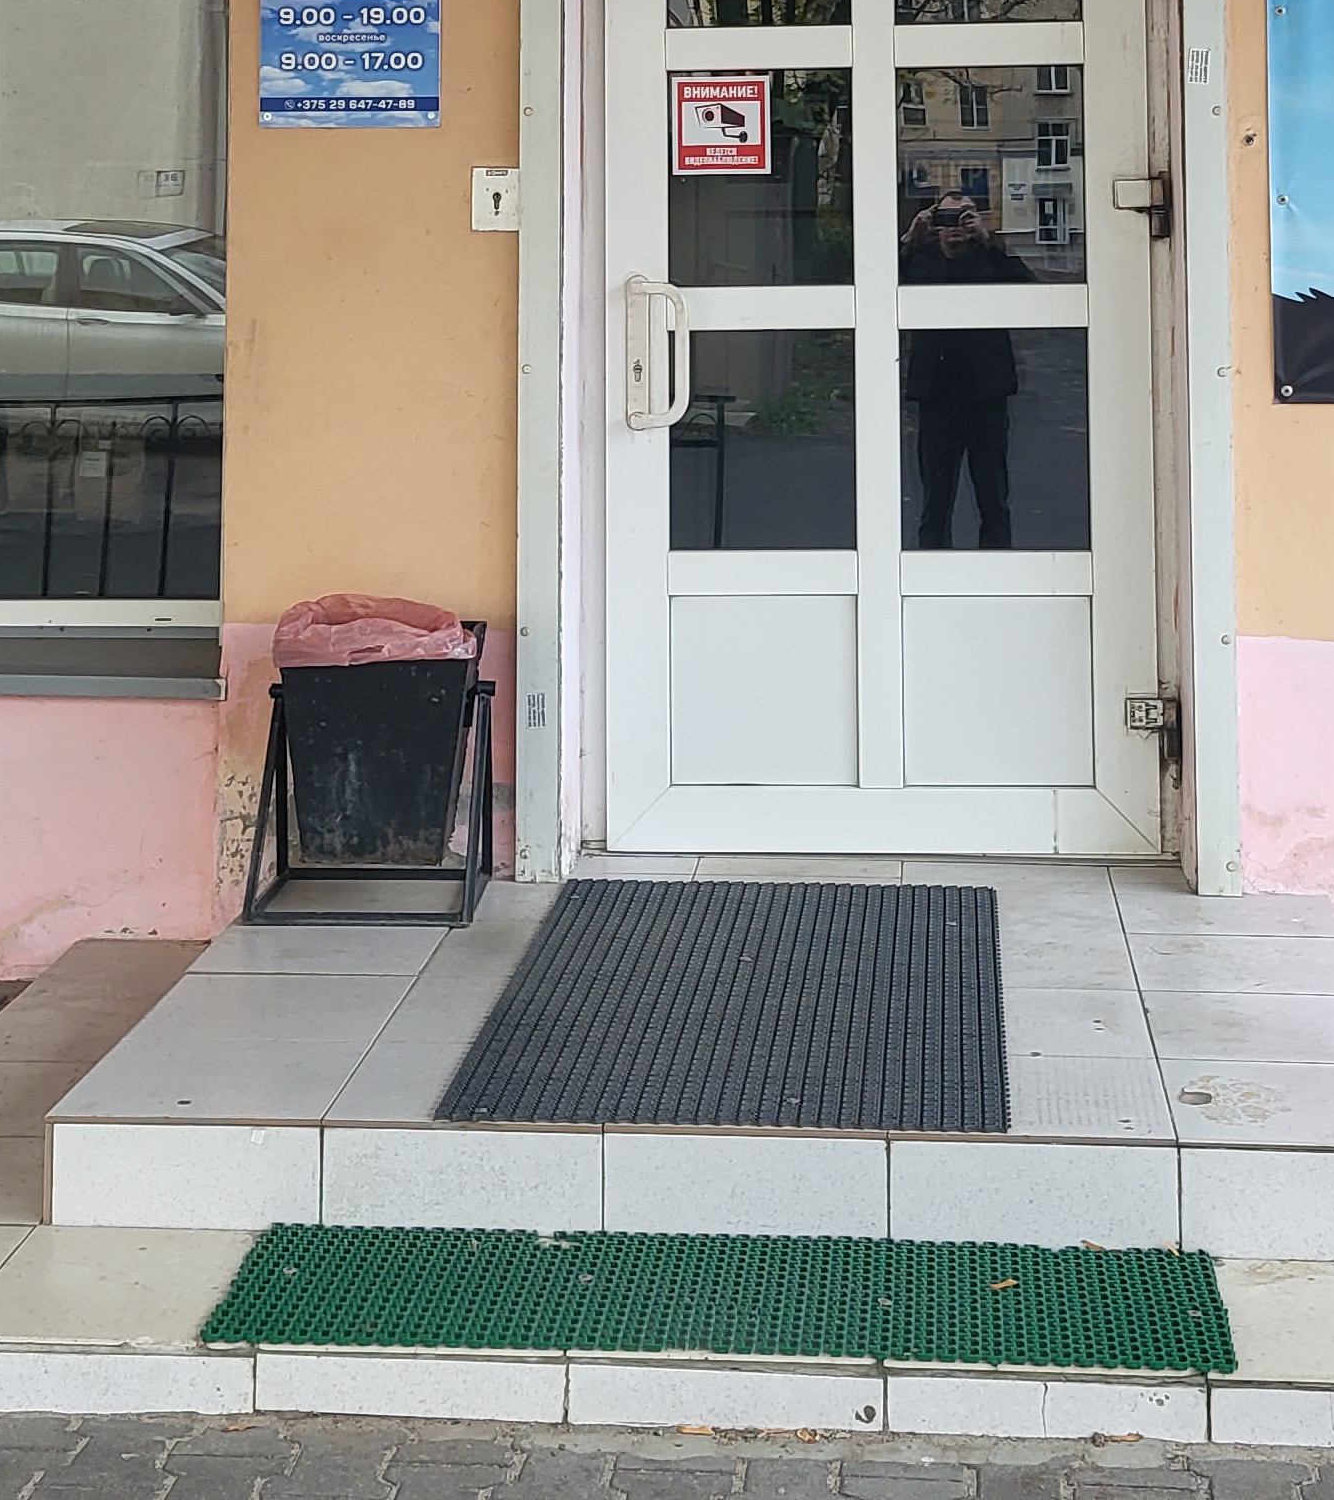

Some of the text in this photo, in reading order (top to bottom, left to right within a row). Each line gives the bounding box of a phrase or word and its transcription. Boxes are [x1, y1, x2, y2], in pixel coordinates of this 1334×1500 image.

[279, 7, 335, 25] 9.00
[360, 7, 426, 25] 19.00
[318, 34, 386, 43] воскресенье
[280, 52, 337, 70] 9.00
[361, 52, 423, 70] 17.00
[683, 85, 758, 99] ВНИМАНИЕ!
[296, 99, 416, 109] +375 29 647-47-89
